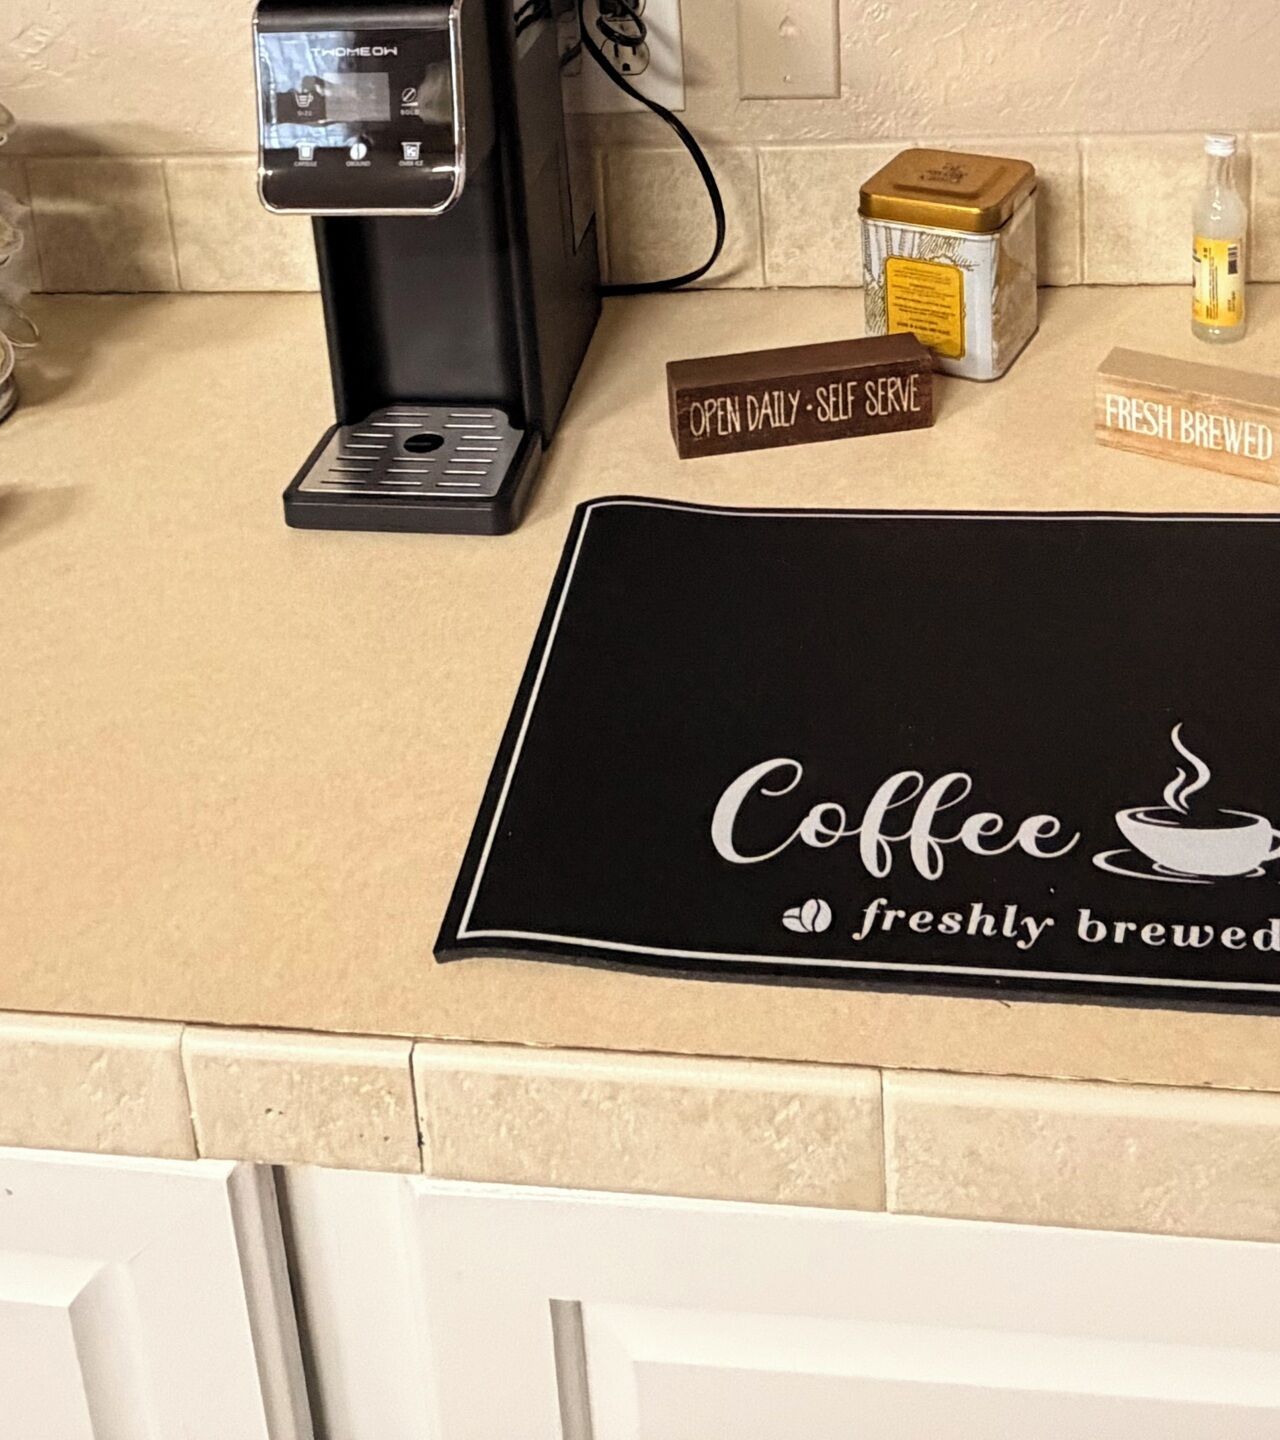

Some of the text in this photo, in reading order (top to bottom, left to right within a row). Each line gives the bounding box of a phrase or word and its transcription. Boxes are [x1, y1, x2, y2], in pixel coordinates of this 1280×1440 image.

[310, 46, 398, 57] TWOMEOW
[689, 373, 920, 437] OPEN DAILY SELF SERVE
[1104, 392, 1273, 461] FRESH BREWED
[709, 756, 1083, 882] Coffee
[851, 896, 1056, 952] freshly
